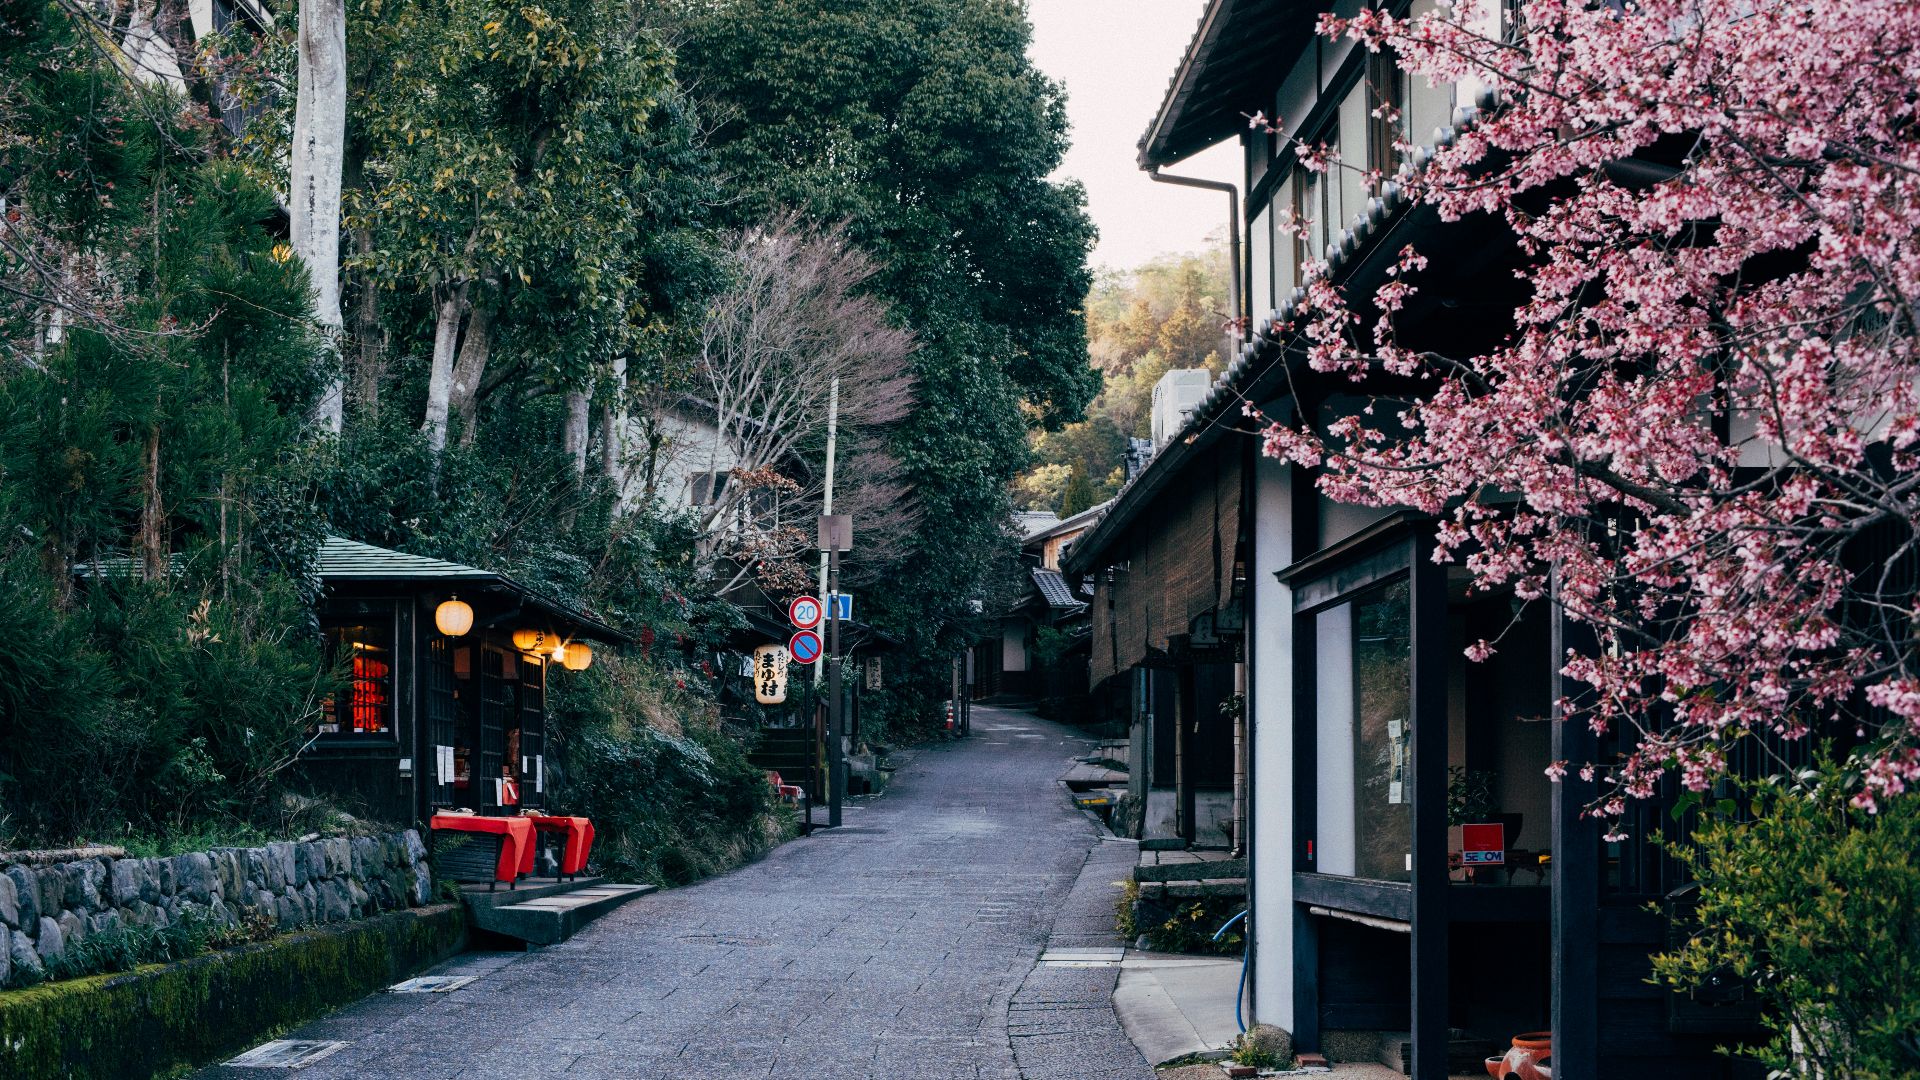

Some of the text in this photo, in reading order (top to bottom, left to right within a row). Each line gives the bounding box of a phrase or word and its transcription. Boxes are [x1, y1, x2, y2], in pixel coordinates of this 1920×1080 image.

[797, 605, 814, 620] 20
[761, 653, 778, 696] まゆ村
[1466, 852, 1501, 861] SECOM
